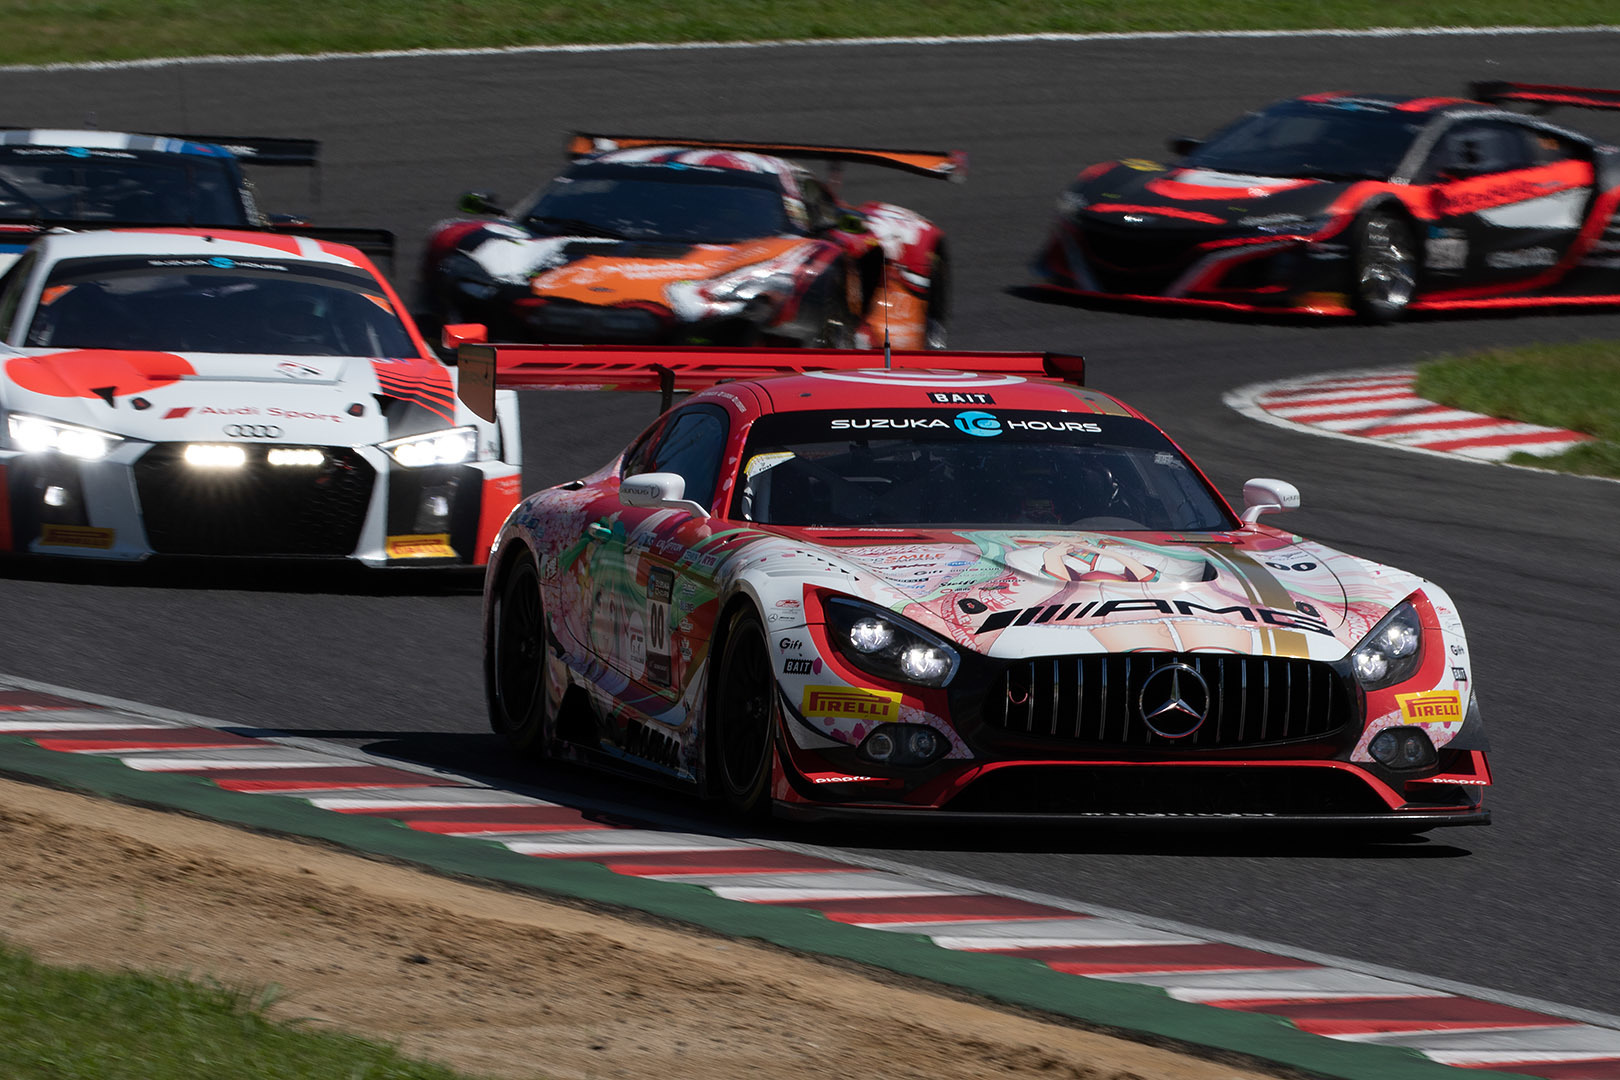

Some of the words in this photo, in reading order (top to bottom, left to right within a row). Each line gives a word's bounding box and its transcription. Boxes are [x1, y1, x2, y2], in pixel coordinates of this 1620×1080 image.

[933, 393, 986, 404] BAIT
[199, 406, 258, 416] Audi
[266, 407, 344, 424] Sport
[830, 418, 950, 430] SUZUKA
[1007, 420, 1102, 433] HOURS
[650, 602, 665, 650] 00
[1091, 600, 1336, 638] AMG
[779, 637, 803, 650] Gift
[785, 660, 812, 674] BAIT
[809, 691, 892, 716] PIRELLI
[1405, 696, 1460, 718] PIRELLI
